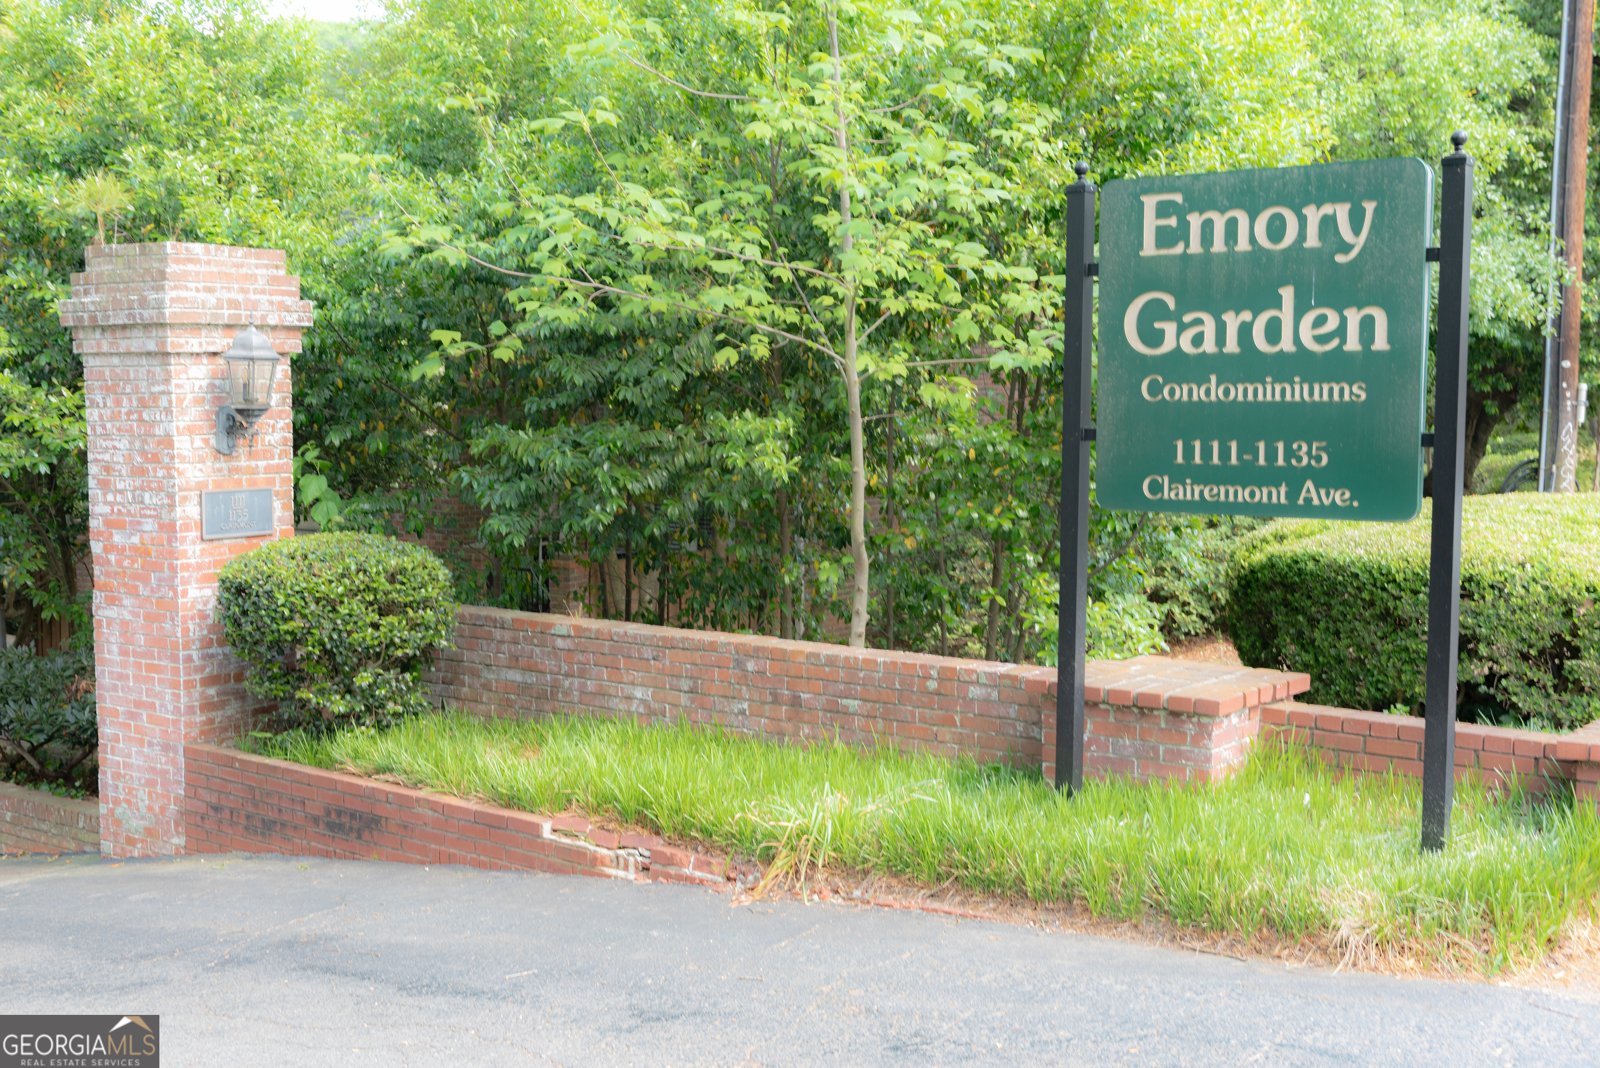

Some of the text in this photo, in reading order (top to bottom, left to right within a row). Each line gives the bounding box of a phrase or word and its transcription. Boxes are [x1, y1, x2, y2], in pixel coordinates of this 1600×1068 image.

[1138, 192, 1378, 264] Emory
[1123, 284, 1391, 356] Garden
[1140, 373, 1367, 402] Condominiums
[1173, 439, 1329, 467] 1111-1135
[1142, 475, 1359, 507] Clairemont Ave.
